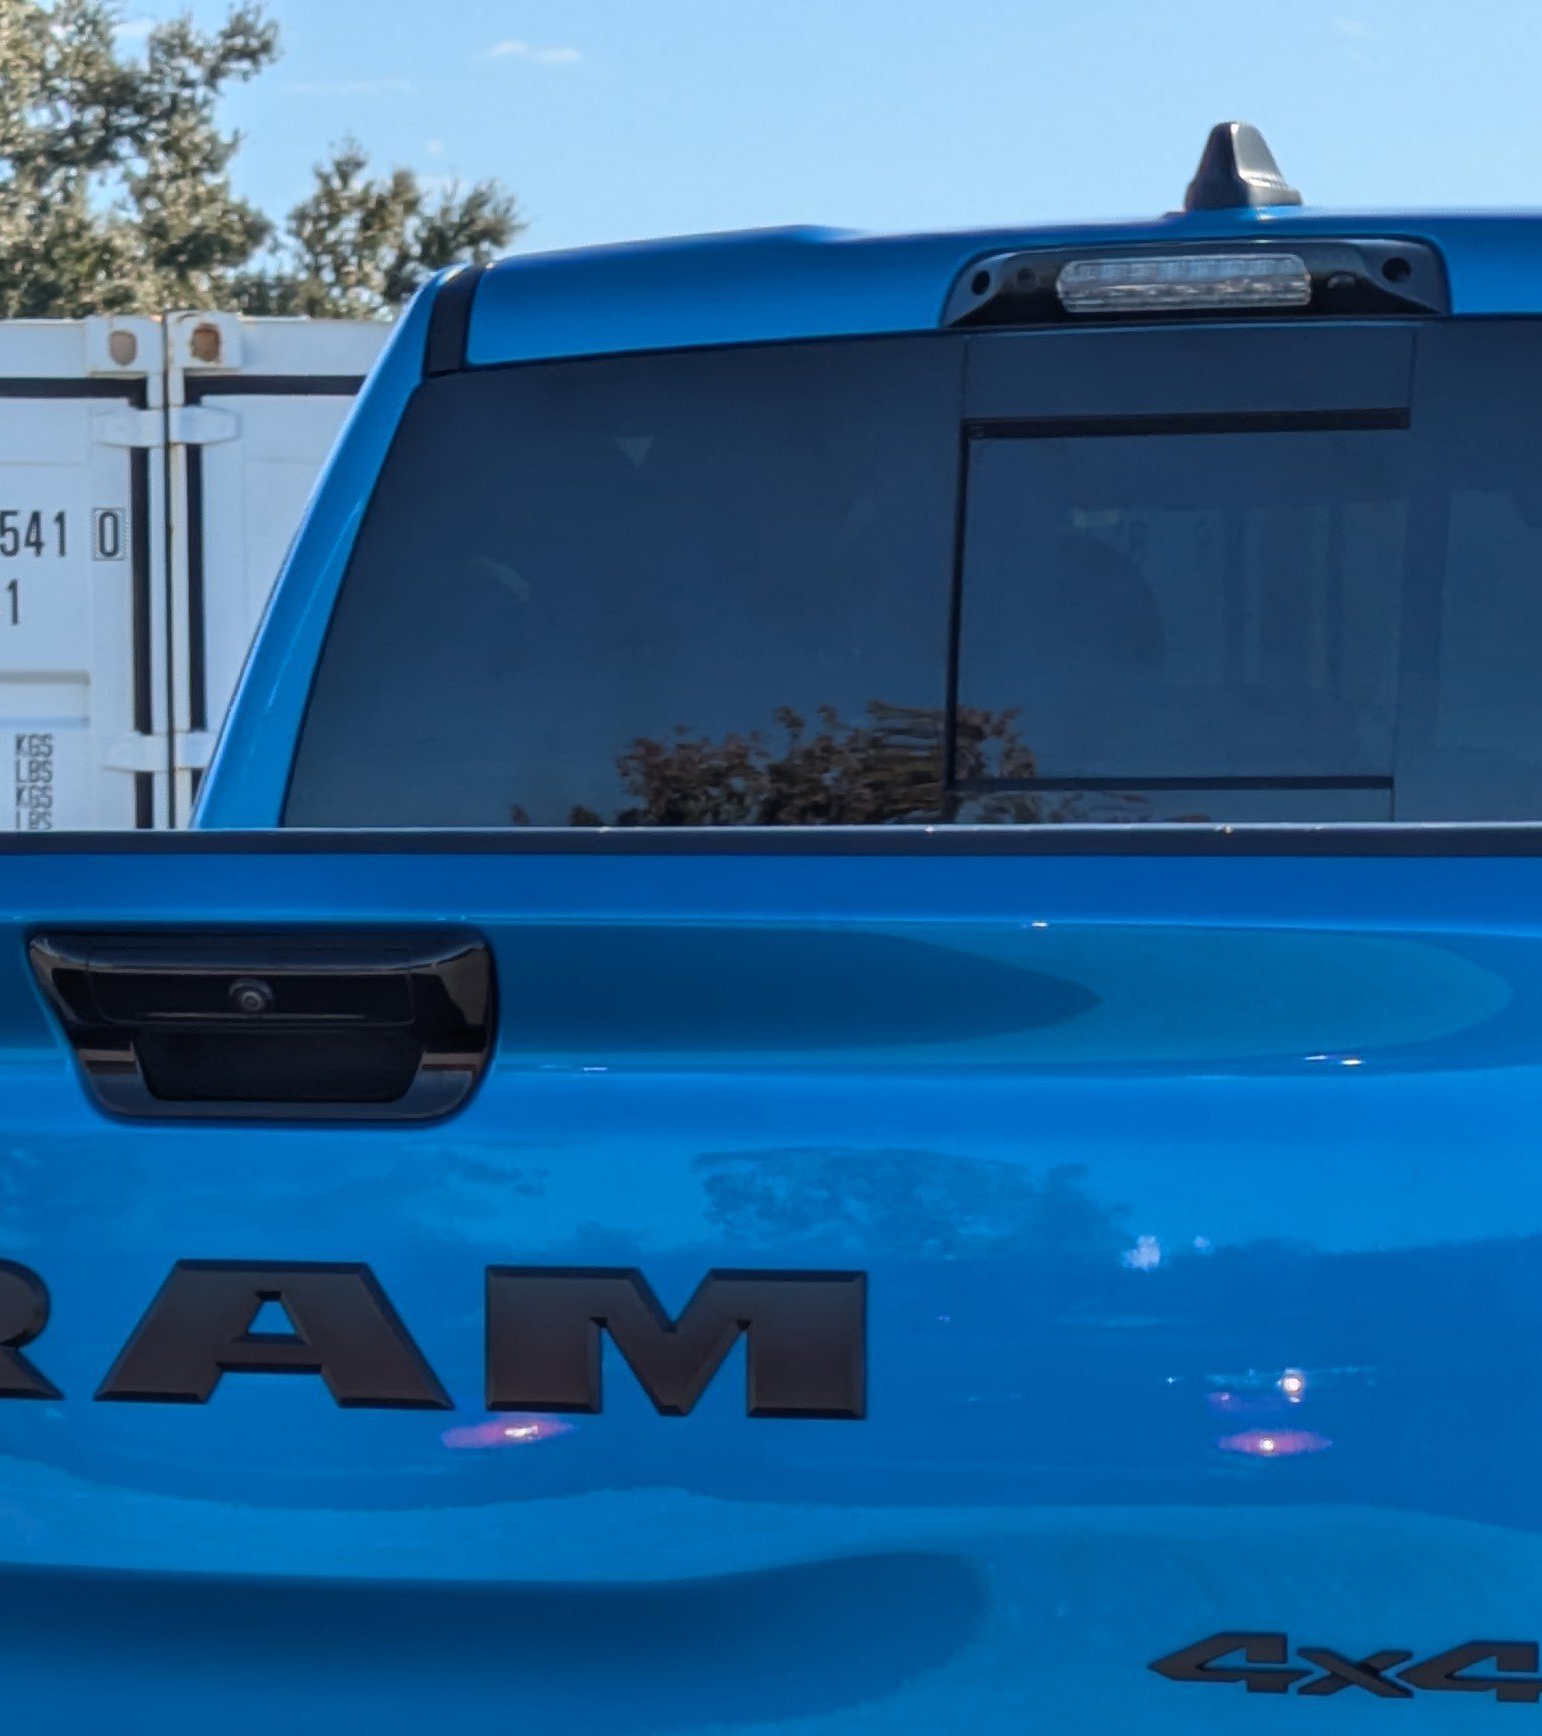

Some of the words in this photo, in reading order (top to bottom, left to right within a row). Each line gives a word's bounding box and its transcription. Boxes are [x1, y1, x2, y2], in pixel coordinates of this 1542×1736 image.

[15, 732, 53, 757] KGS
[15, 758, 52, 783] LBS
[15, 783, 53, 809] KGS
